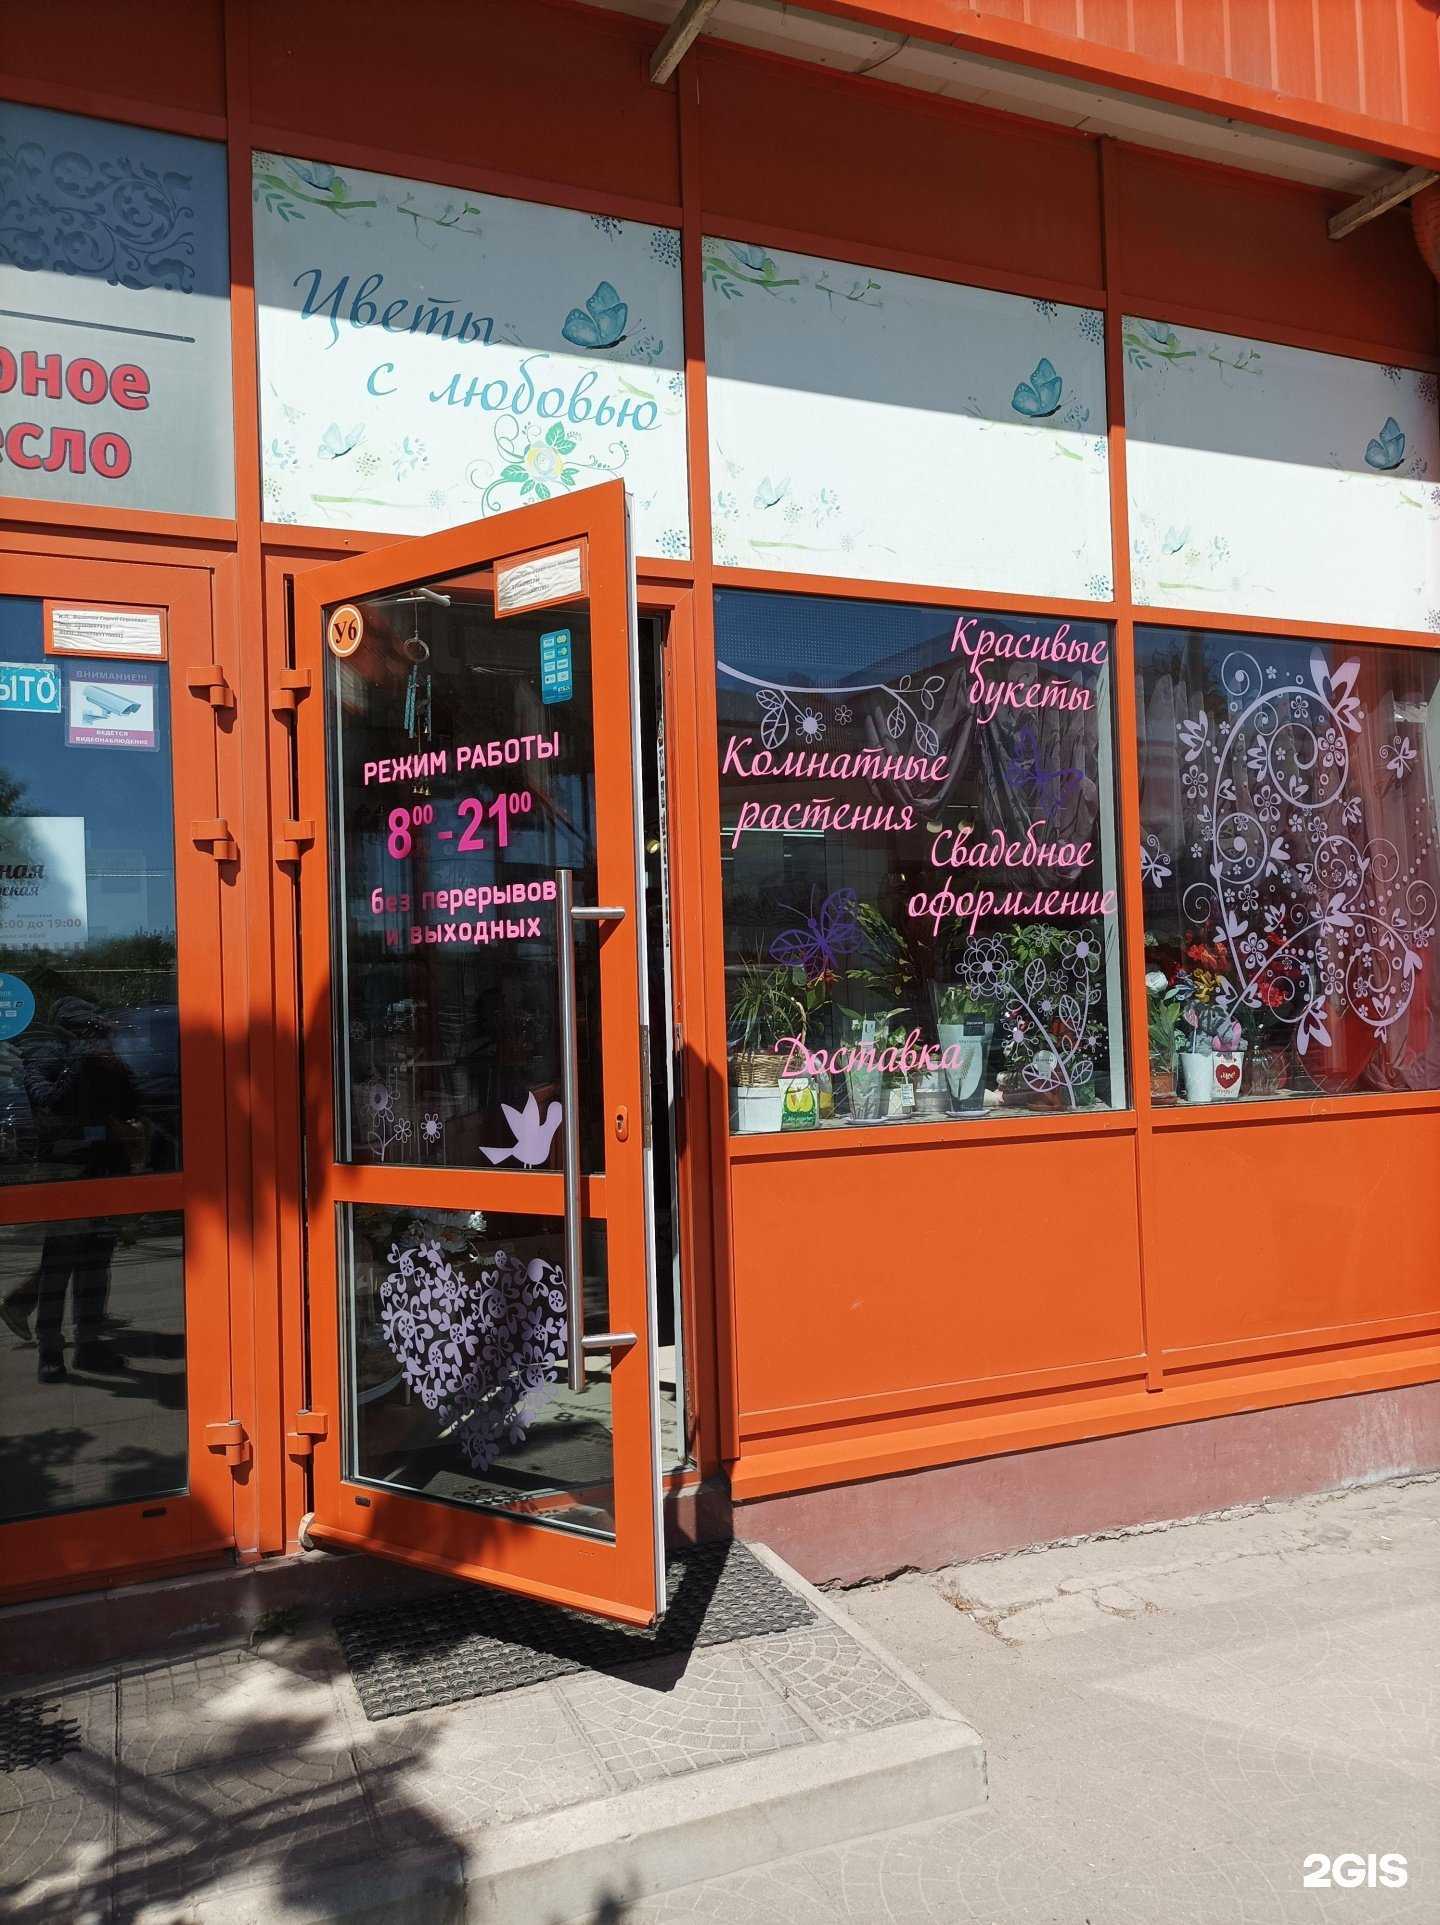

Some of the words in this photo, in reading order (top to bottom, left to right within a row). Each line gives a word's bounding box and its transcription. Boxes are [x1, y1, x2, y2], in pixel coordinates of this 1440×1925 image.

[293, 268, 503, 350] Цветы
[366, 362, 398, 396] с
[429, 354, 662, 431] любовью
[0, 422, 132, 479] сло
[950, 617, 1109, 674] Красивые
[969, 658, 1094, 724] букеты
[364, 750, 447, 785] РЕЖИМ
[457, 731, 560, 771] РАБОТЫ
[722, 735, 950, 782] Комнатные
[731, 797, 918, 850] растения
[931, 820, 1095, 868] Свадебное
[371, 887, 410, 915] без
[422, 880, 557, 916] перерывов
[908, 875, 1118, 937] оформление
[410, 917, 541, 946] выходных
[774, 1028, 964, 1078] Доставка
